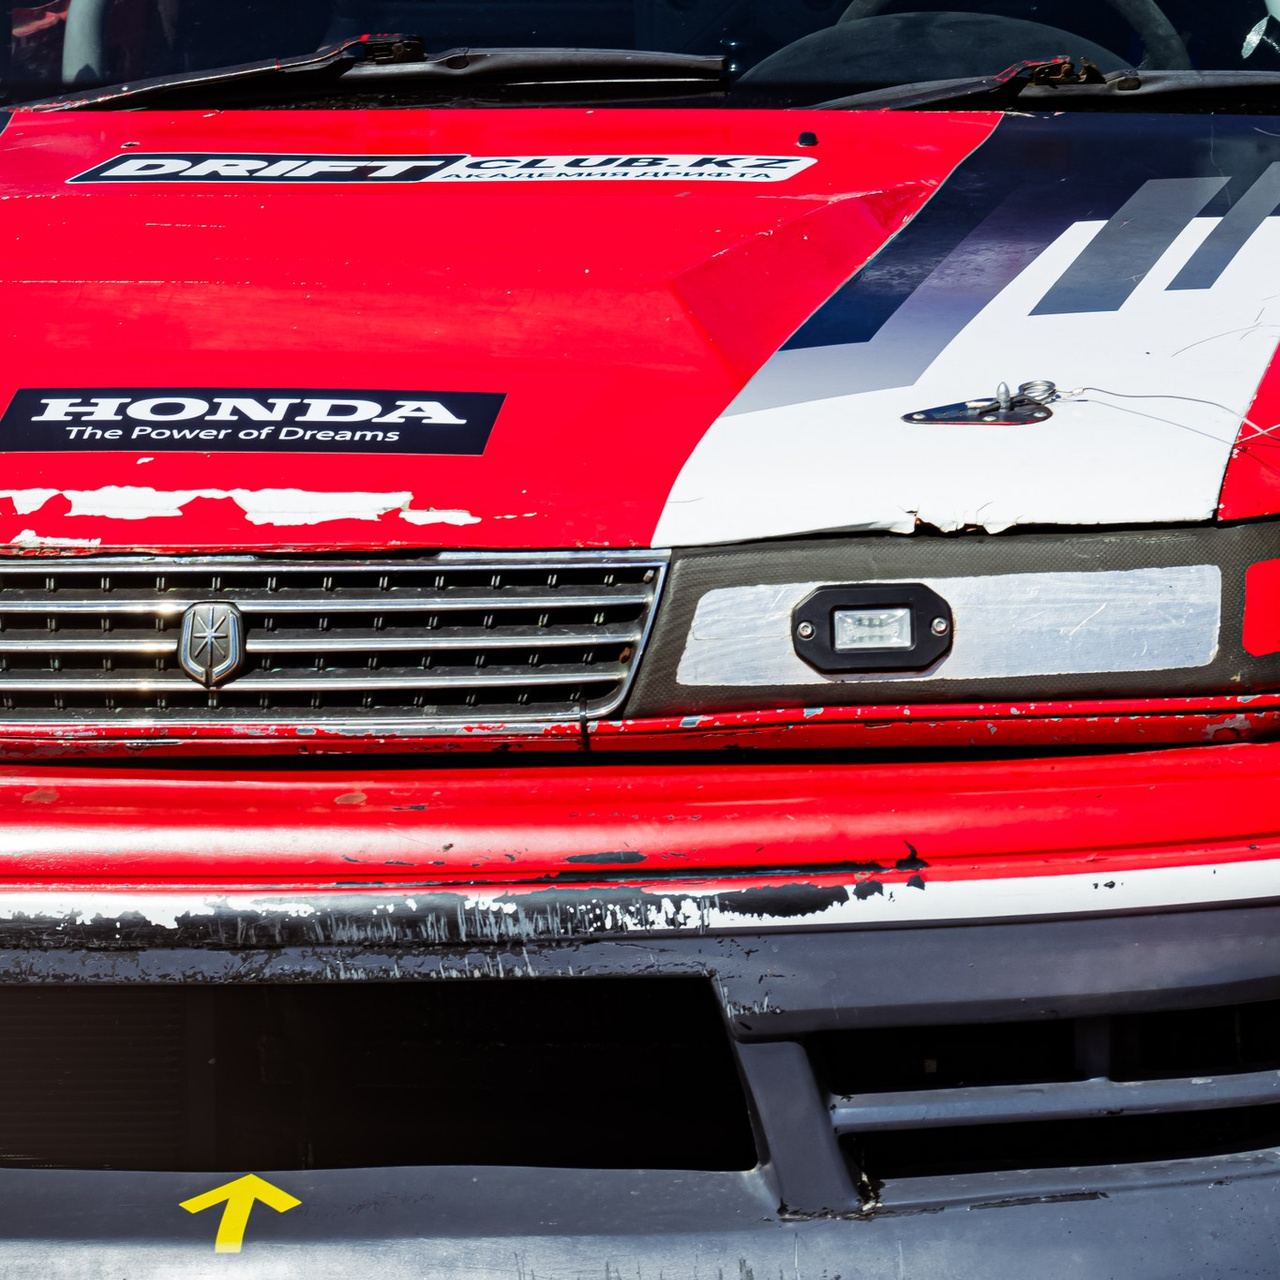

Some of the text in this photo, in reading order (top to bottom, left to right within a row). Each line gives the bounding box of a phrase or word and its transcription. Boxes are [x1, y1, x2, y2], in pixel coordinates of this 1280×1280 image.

[99, 157, 801, 178] DRIFT CLUB.KZ
[441, 171, 772, 179] АКАДЕМИЯ ДРИФТА
[31, 397, 467, 425] HONDA
[65, 426, 400, 441] The Power of Dreams
